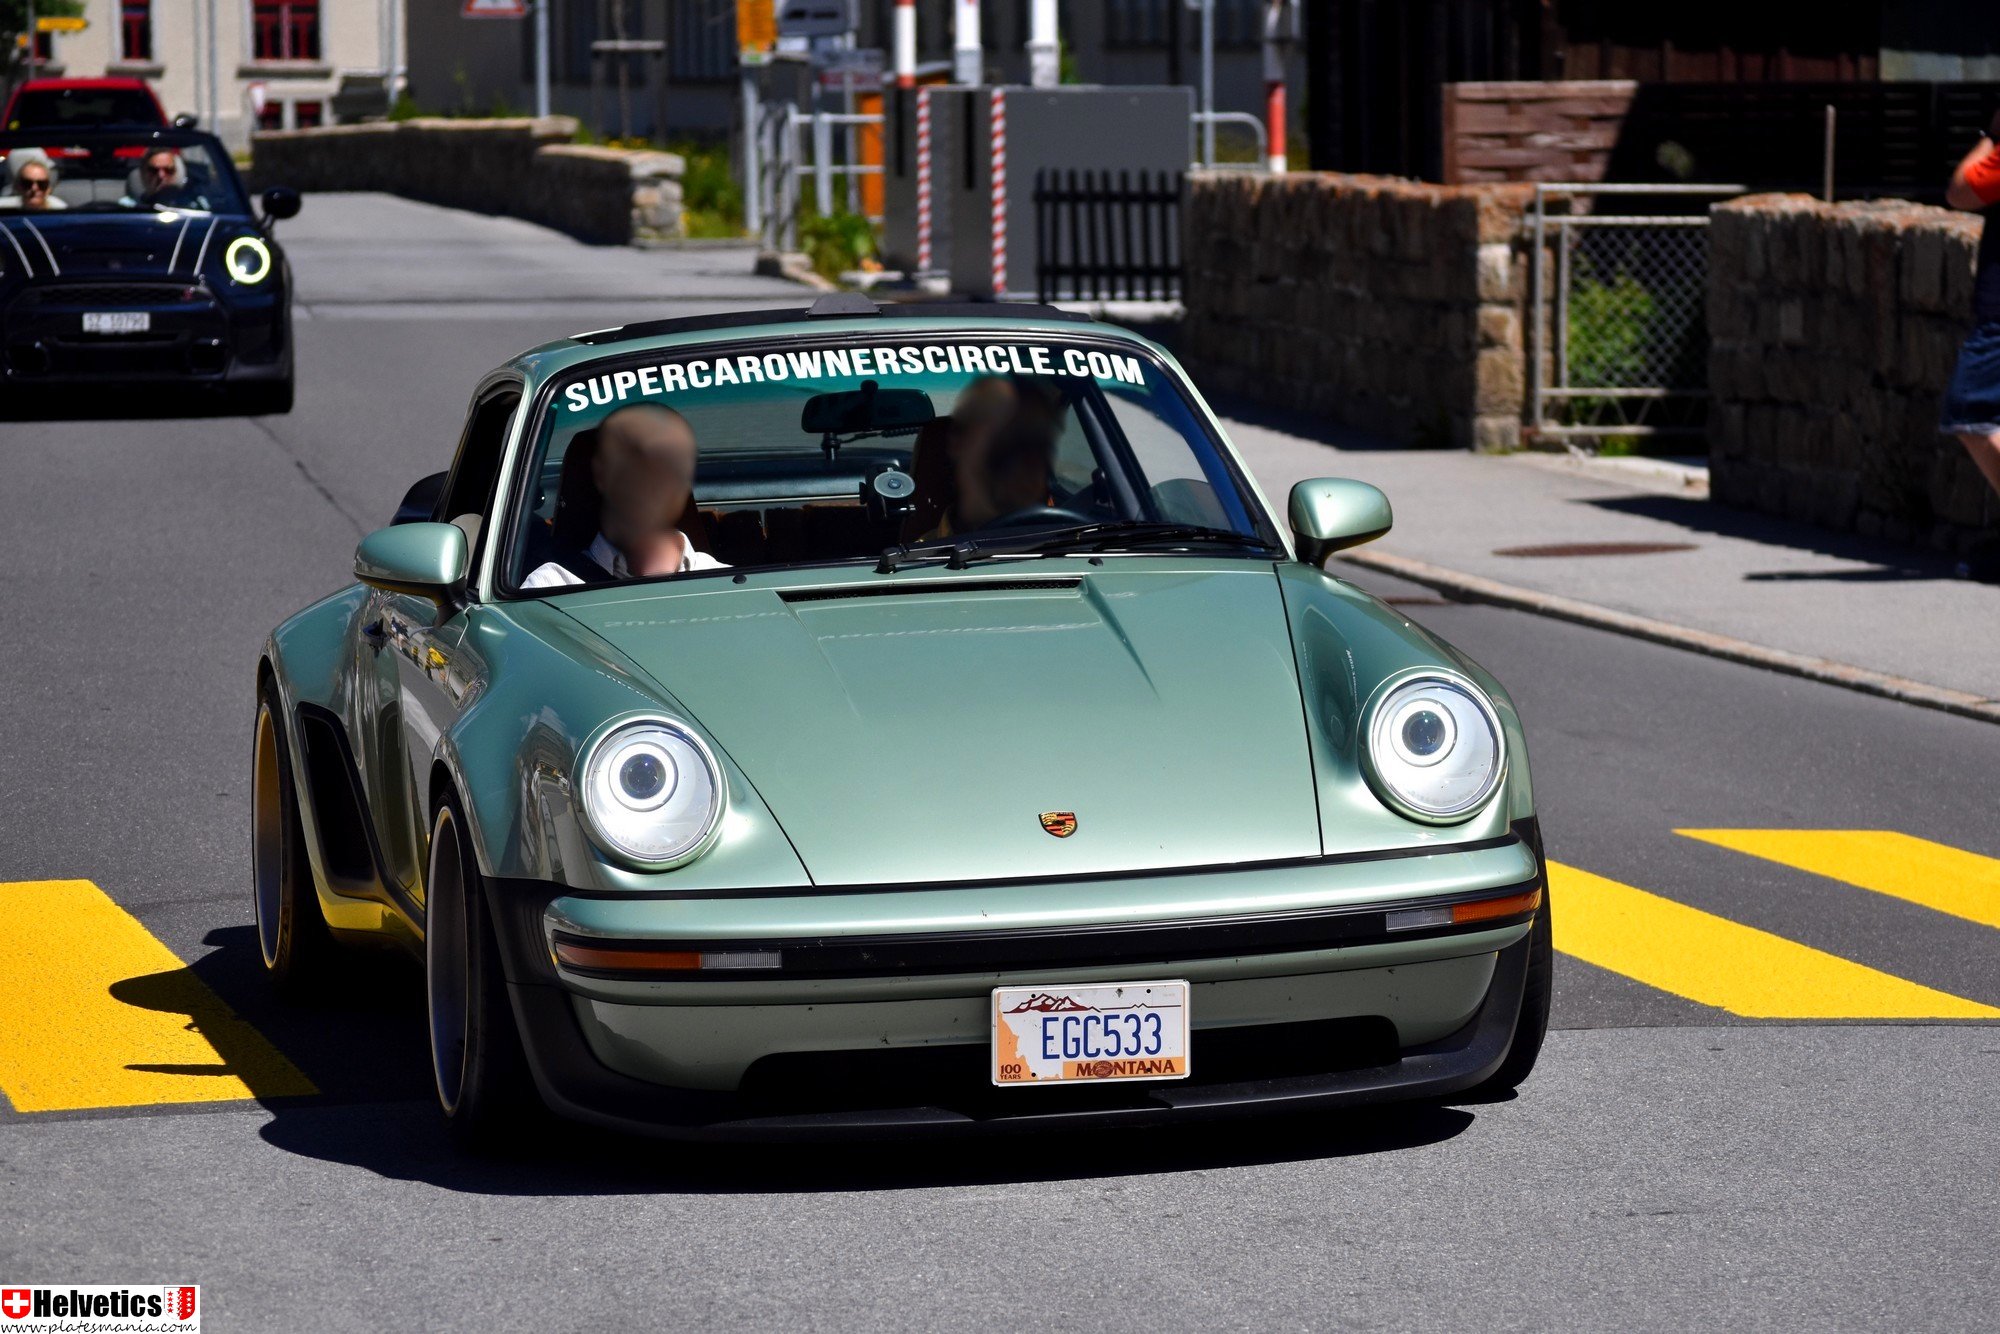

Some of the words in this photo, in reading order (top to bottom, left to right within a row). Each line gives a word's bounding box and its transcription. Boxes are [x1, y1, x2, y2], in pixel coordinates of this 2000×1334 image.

[565, 345, 1145, 411] SUPERCAROWNERSCIRCLE.COM
[1042, 1013, 1162, 1060] EGC533
[1000, 1063, 1021, 1075] 100
[1076, 1059, 1176, 1079] MONTANA
